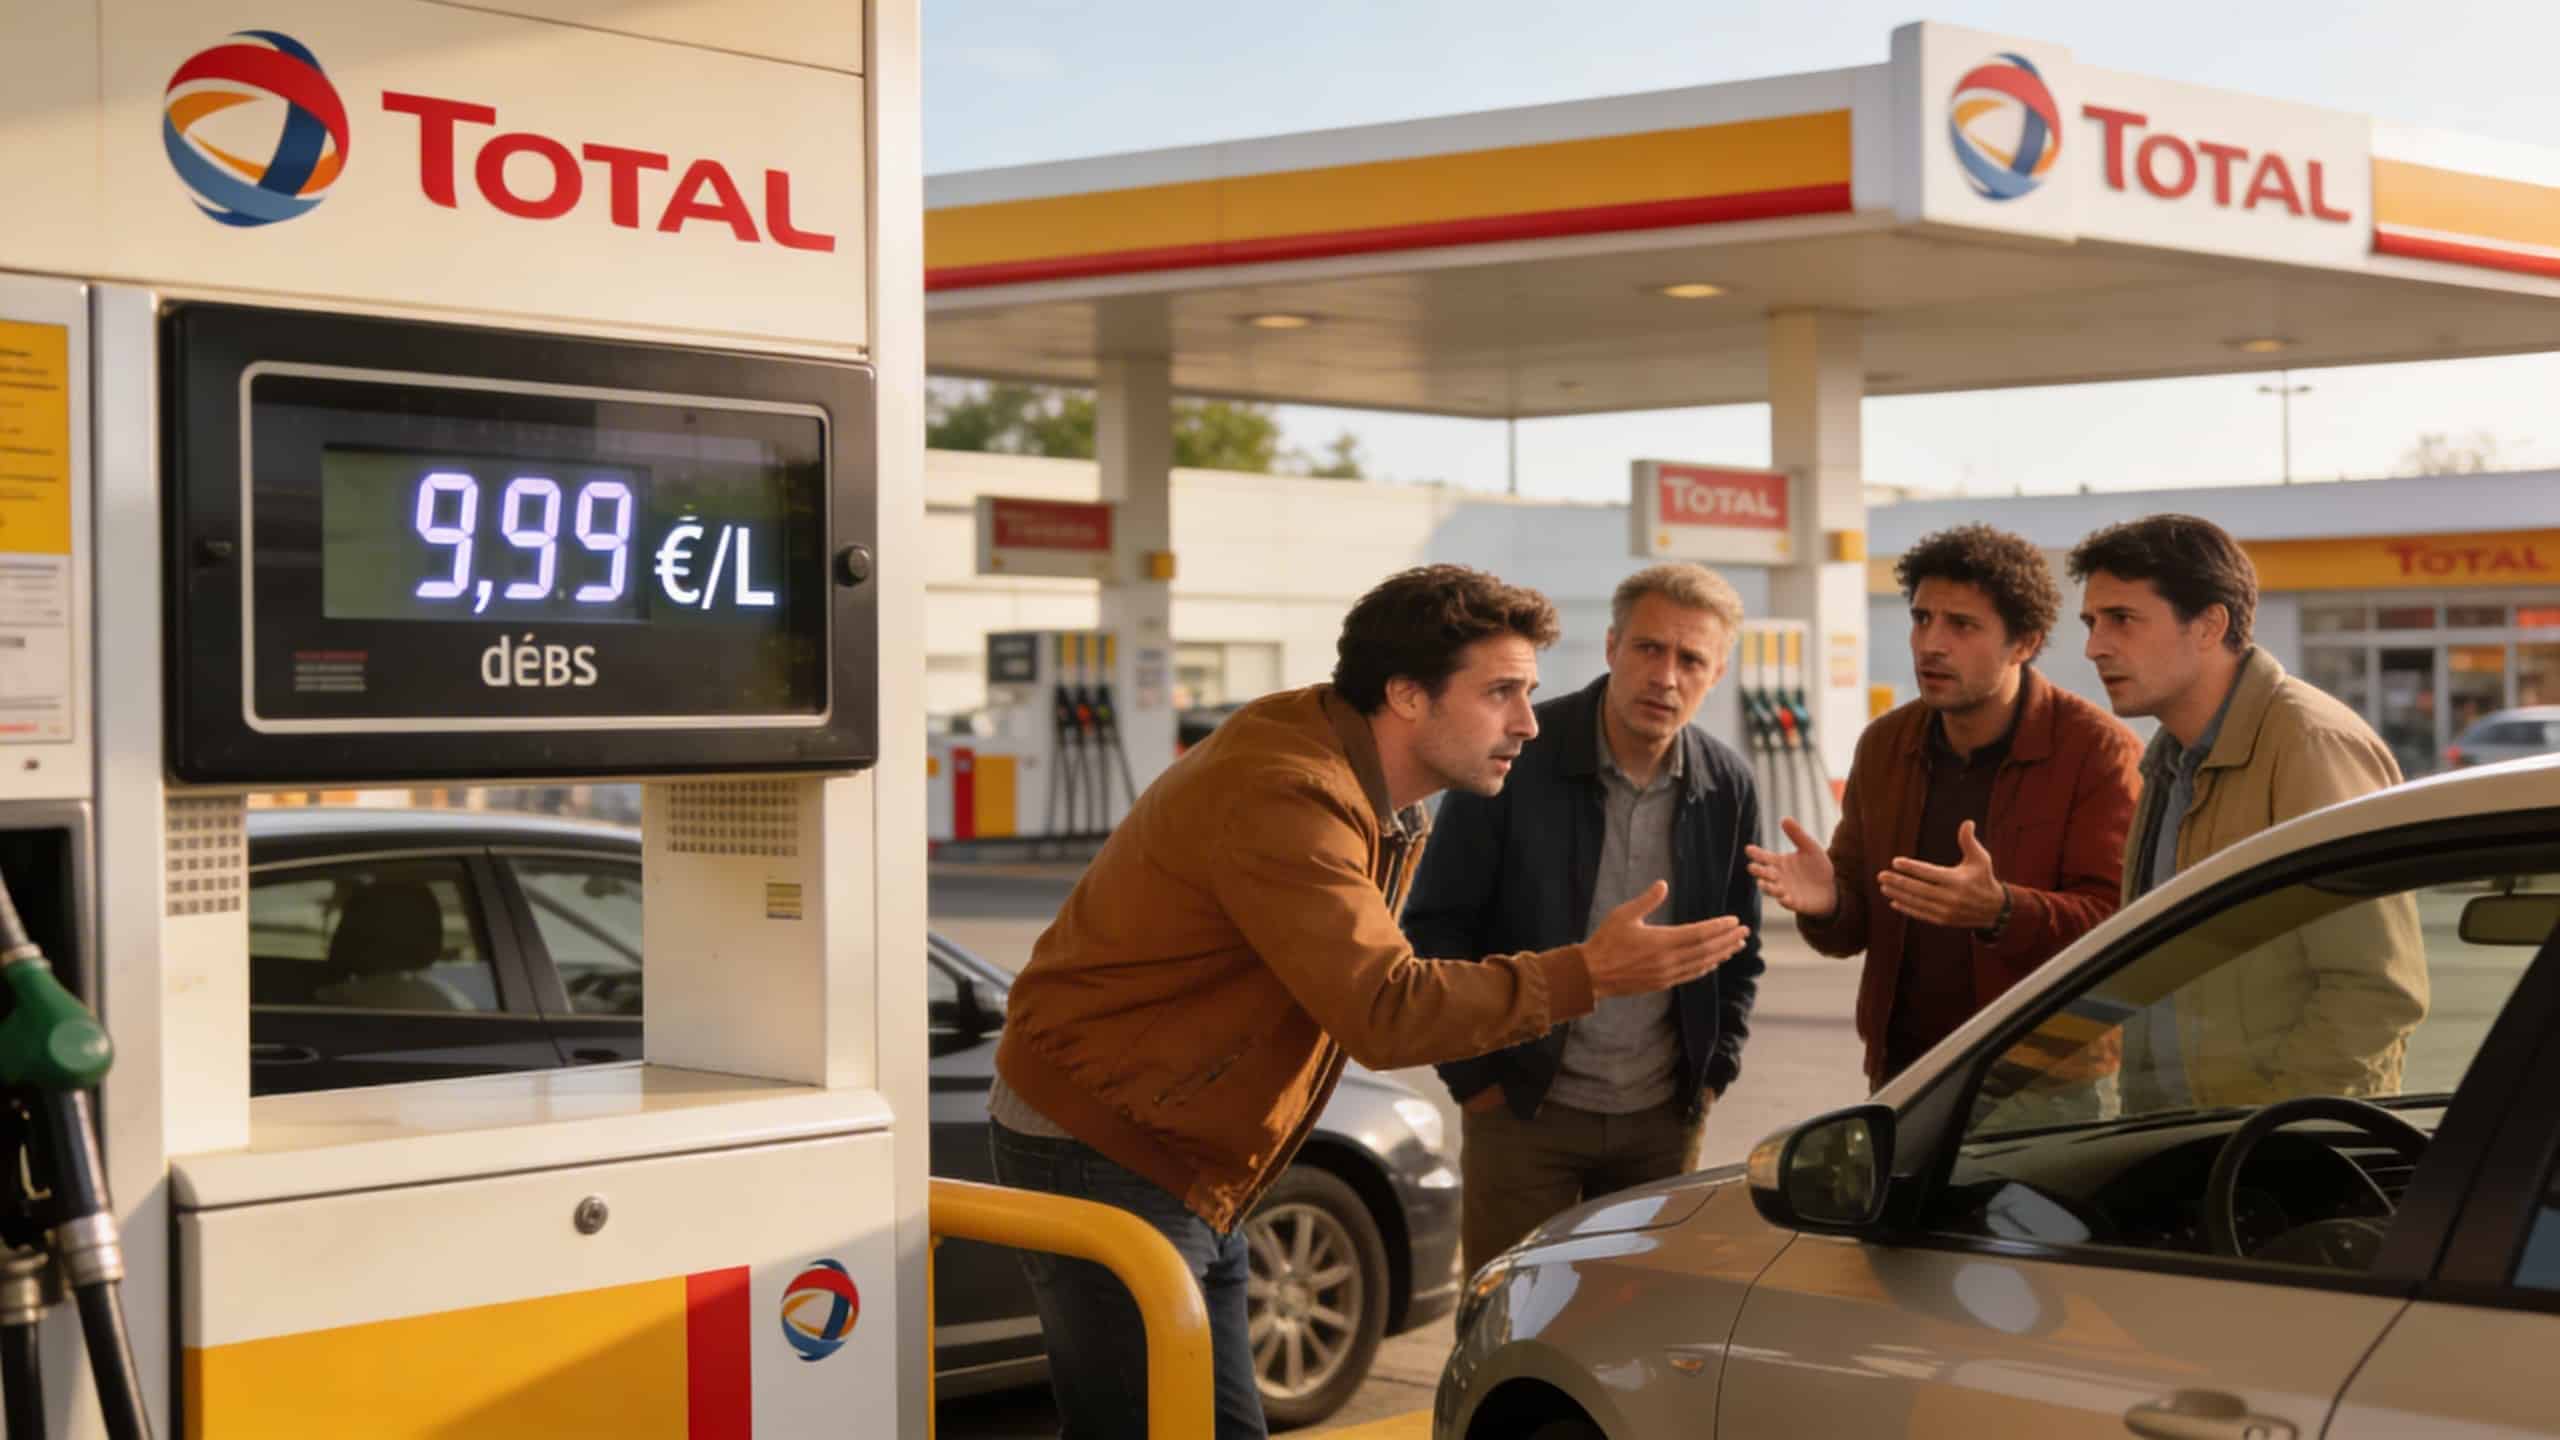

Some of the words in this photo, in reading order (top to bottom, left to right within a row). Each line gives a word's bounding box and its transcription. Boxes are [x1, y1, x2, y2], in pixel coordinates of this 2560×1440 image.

[381, 90, 836, 253] TOTAL
[2083, 104, 2353, 224] TOTAL
[415, 471, 634, 615] 9,99
[1663, 475, 1779, 519] TOTAL
[2387, 539, 2549, 576] TOTAL
